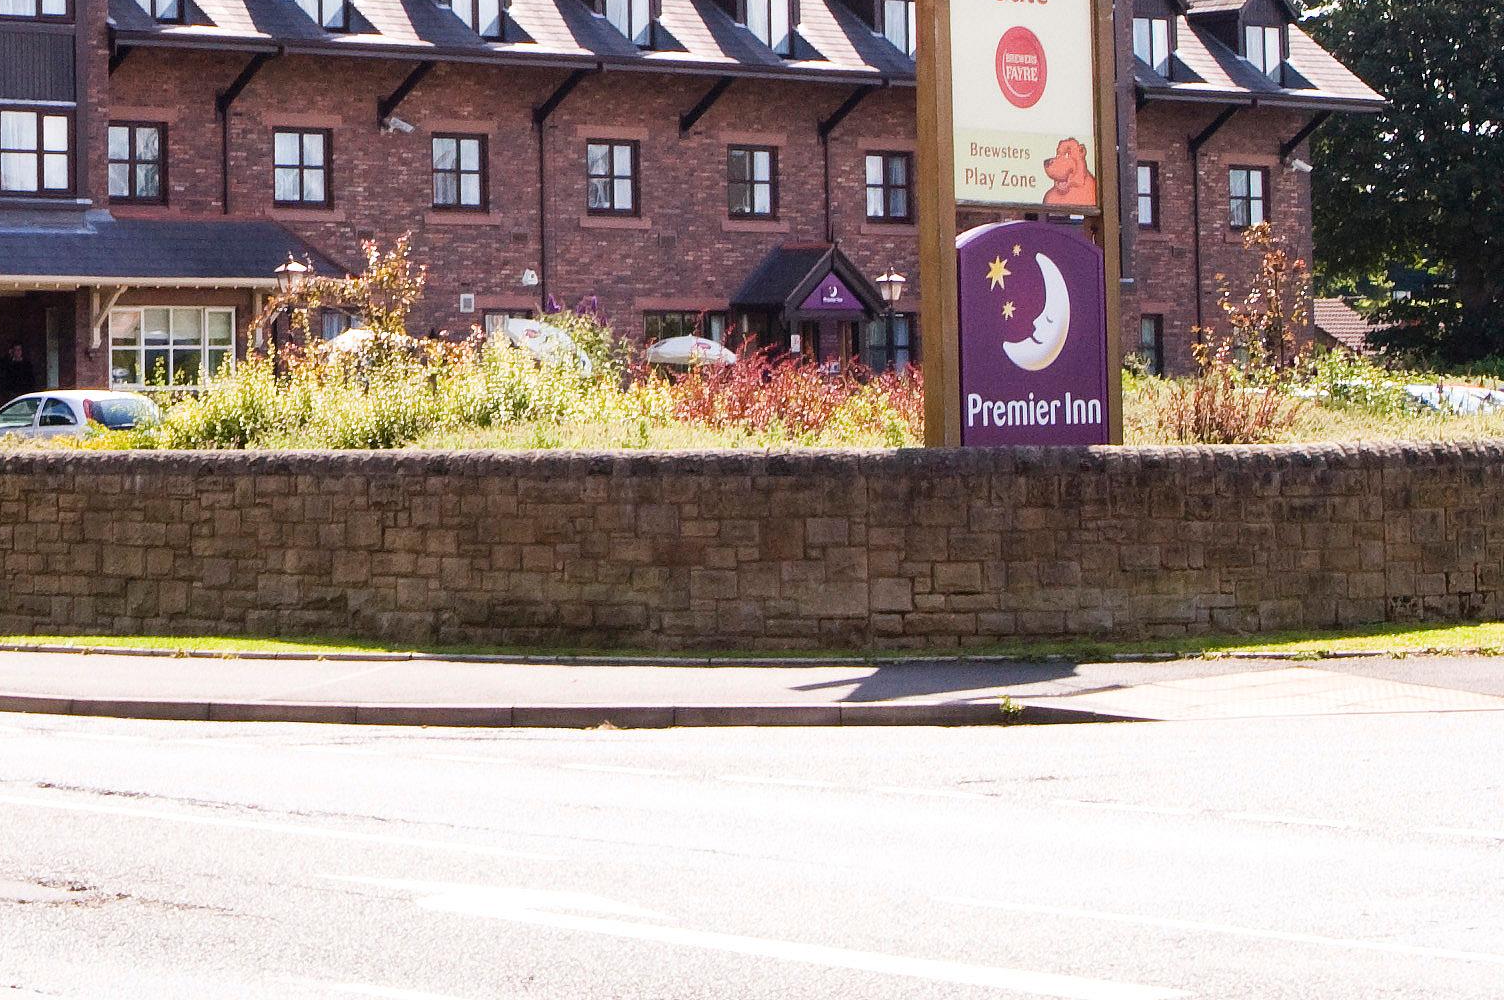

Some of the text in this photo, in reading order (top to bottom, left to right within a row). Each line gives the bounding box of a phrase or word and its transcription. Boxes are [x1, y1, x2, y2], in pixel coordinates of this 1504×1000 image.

[1006, 66, 1039, 82] FAYRE
[970, 142, 1031, 160] Brewsters
[965, 167, 1037, 190] Play Zone
[967, 391, 1102, 427] Premier Inn
